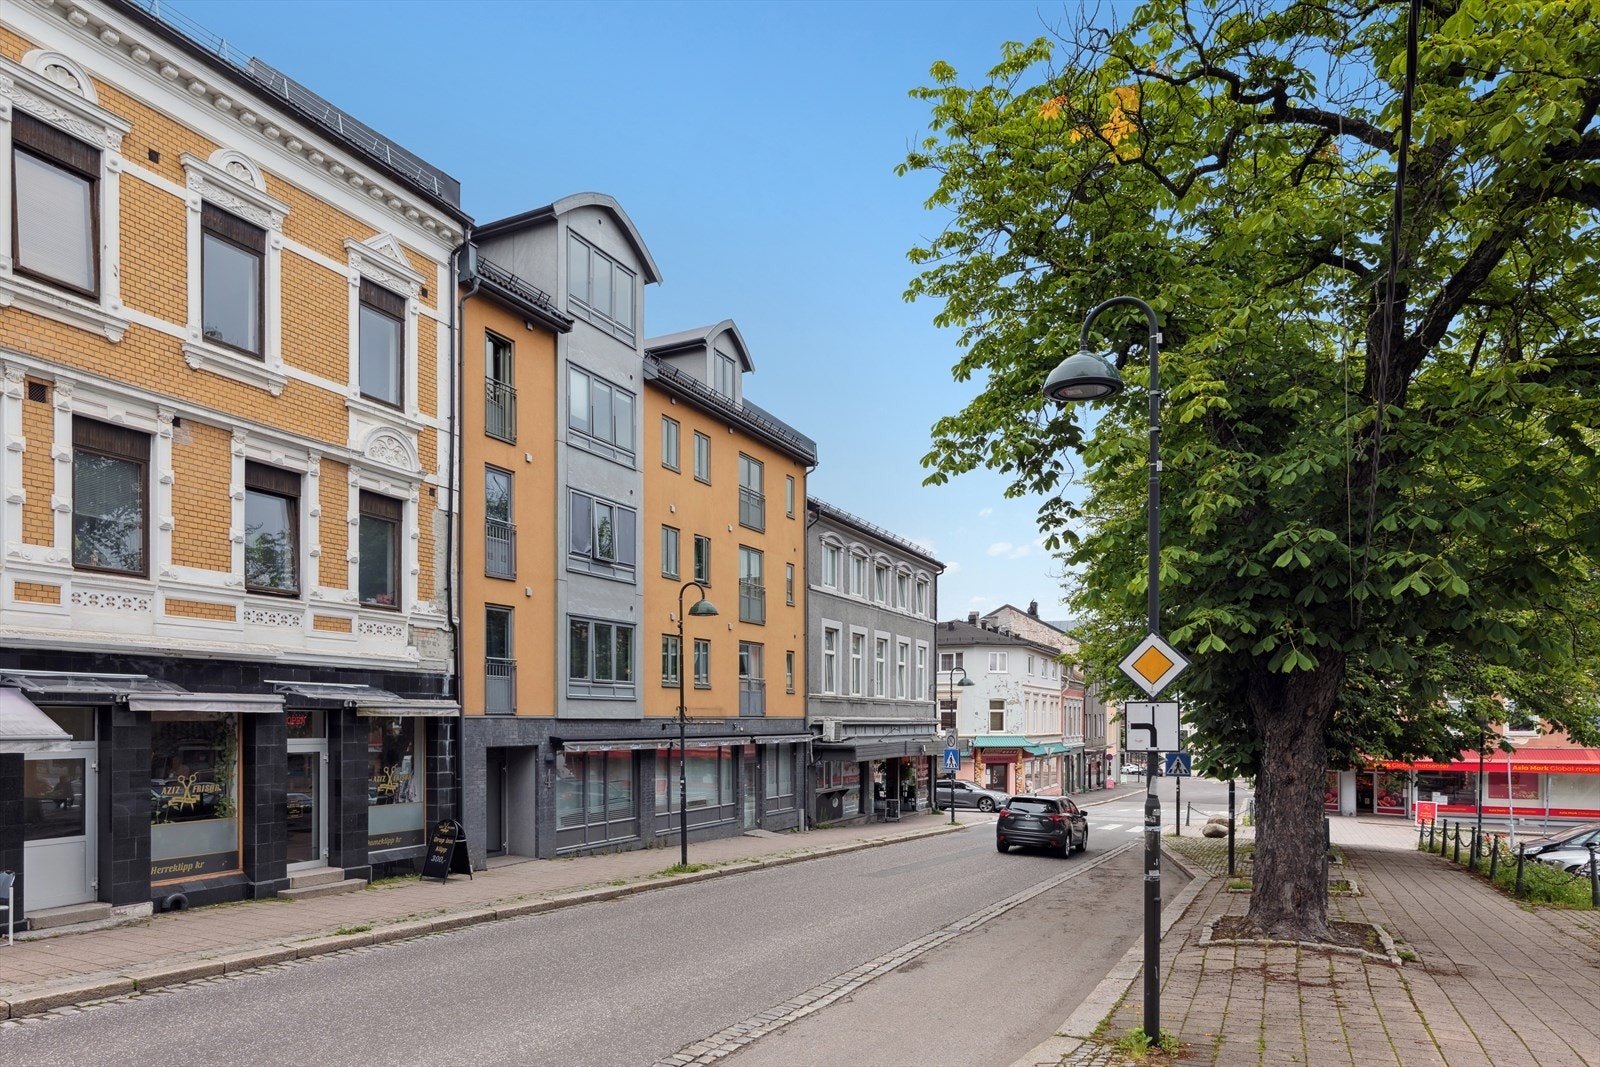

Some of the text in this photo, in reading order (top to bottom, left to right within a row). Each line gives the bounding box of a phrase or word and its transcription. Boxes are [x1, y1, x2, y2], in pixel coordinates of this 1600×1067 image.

[161, 786, 180, 795] AZIZ
[151, 861, 205, 875] Herreklipp kr
